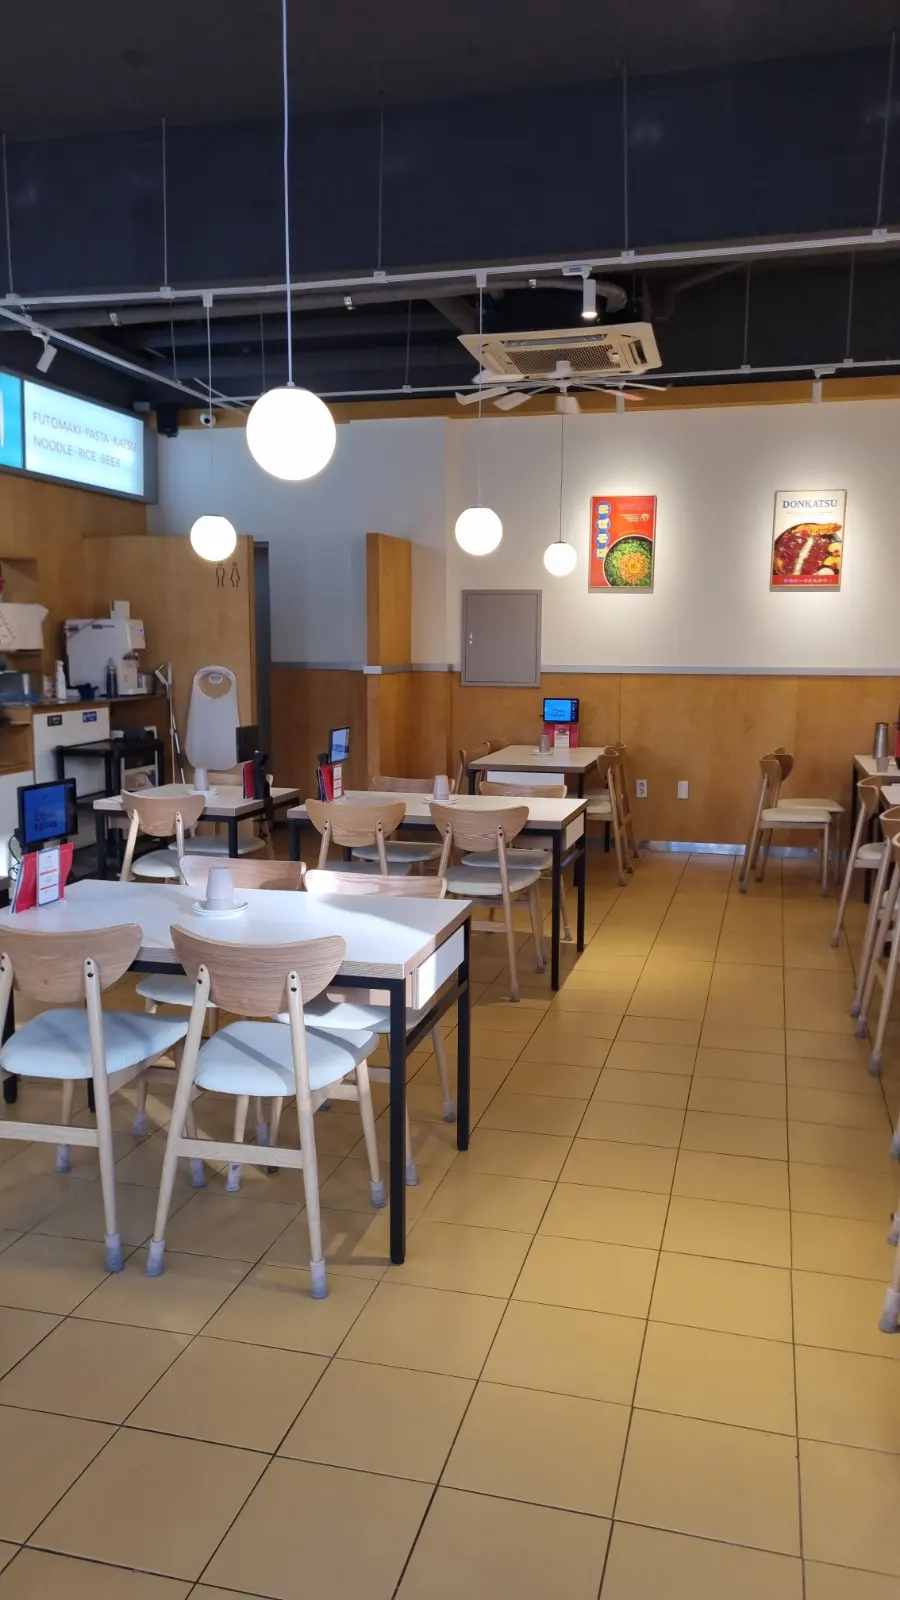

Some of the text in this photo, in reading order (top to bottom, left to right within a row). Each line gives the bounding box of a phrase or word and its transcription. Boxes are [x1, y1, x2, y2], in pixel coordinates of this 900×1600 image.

[33, 411, 137, 452] FUTOMAKI PASTA KATSU
[33, 436, 121, 468] NOODLE RICE BEER
[782, 499, 838, 509] DONKATSU
